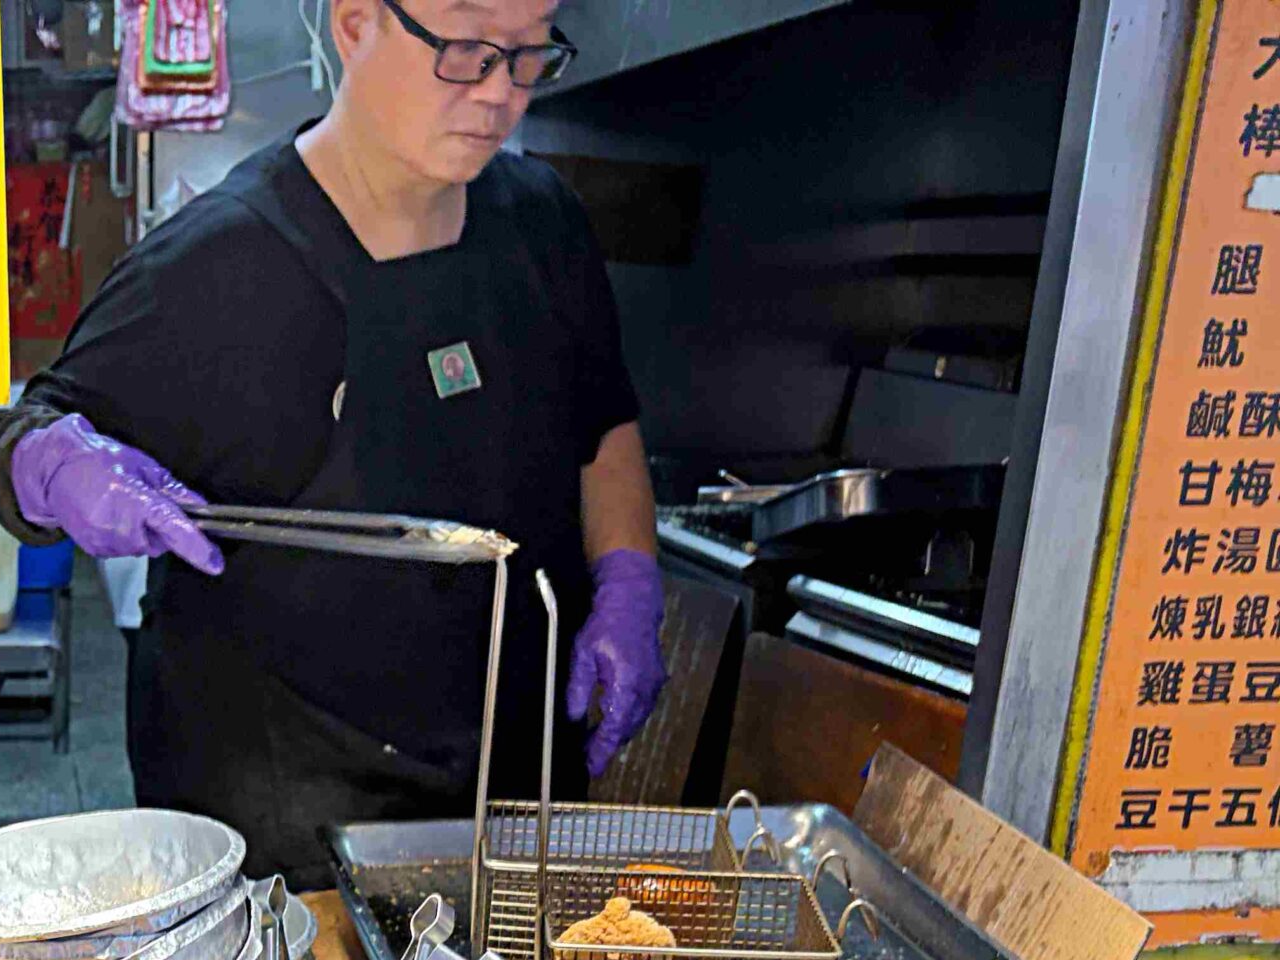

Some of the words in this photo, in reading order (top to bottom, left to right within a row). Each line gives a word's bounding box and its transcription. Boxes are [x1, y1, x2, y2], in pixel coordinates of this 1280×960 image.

[1211, 244, 1263, 296] 腿
[1197, 318, 1248, 369] 魷
[1179, 458, 1280, 507] 甘梅
[1148, 594, 1280, 640] 煉乳銀
[1137, 660, 1280, 706] 雞蛋豆
